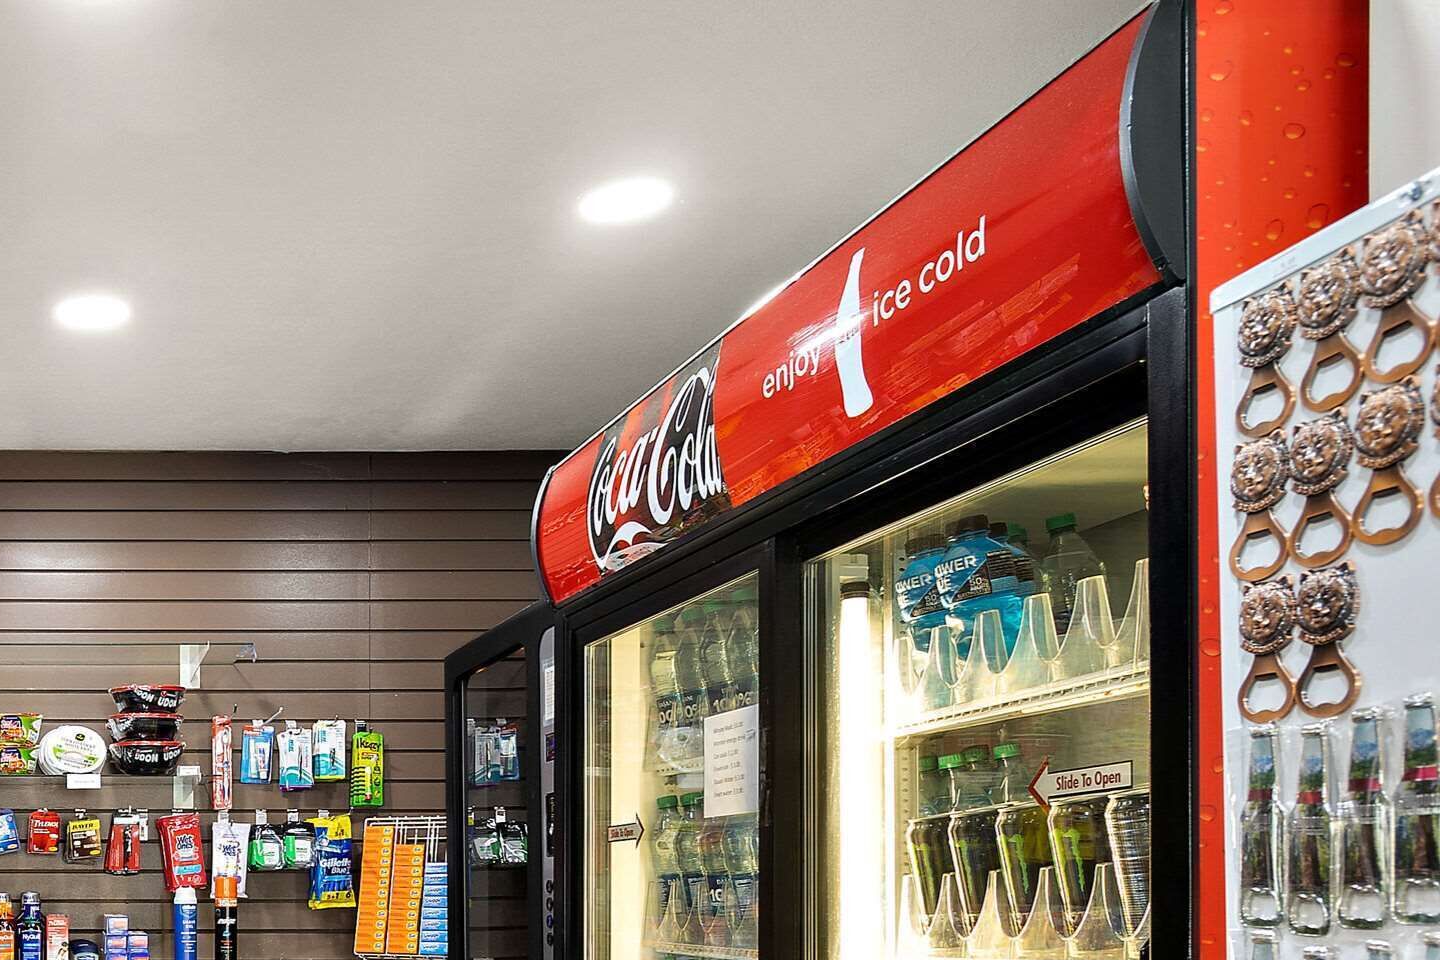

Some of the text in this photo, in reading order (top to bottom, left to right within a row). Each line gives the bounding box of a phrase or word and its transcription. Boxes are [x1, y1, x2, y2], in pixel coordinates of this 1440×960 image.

[762, 215, 987, 398] enjoy ice cold
[586, 358, 726, 570] Coca-Cola
[934, 555, 978, 578] OWER
[895, 573, 933, 593] OWER
[1056, 771, 1121, 790] Slide To Open
[177, 835, 194, 845] Wet
[320, 859, 351, 868] Gillette
